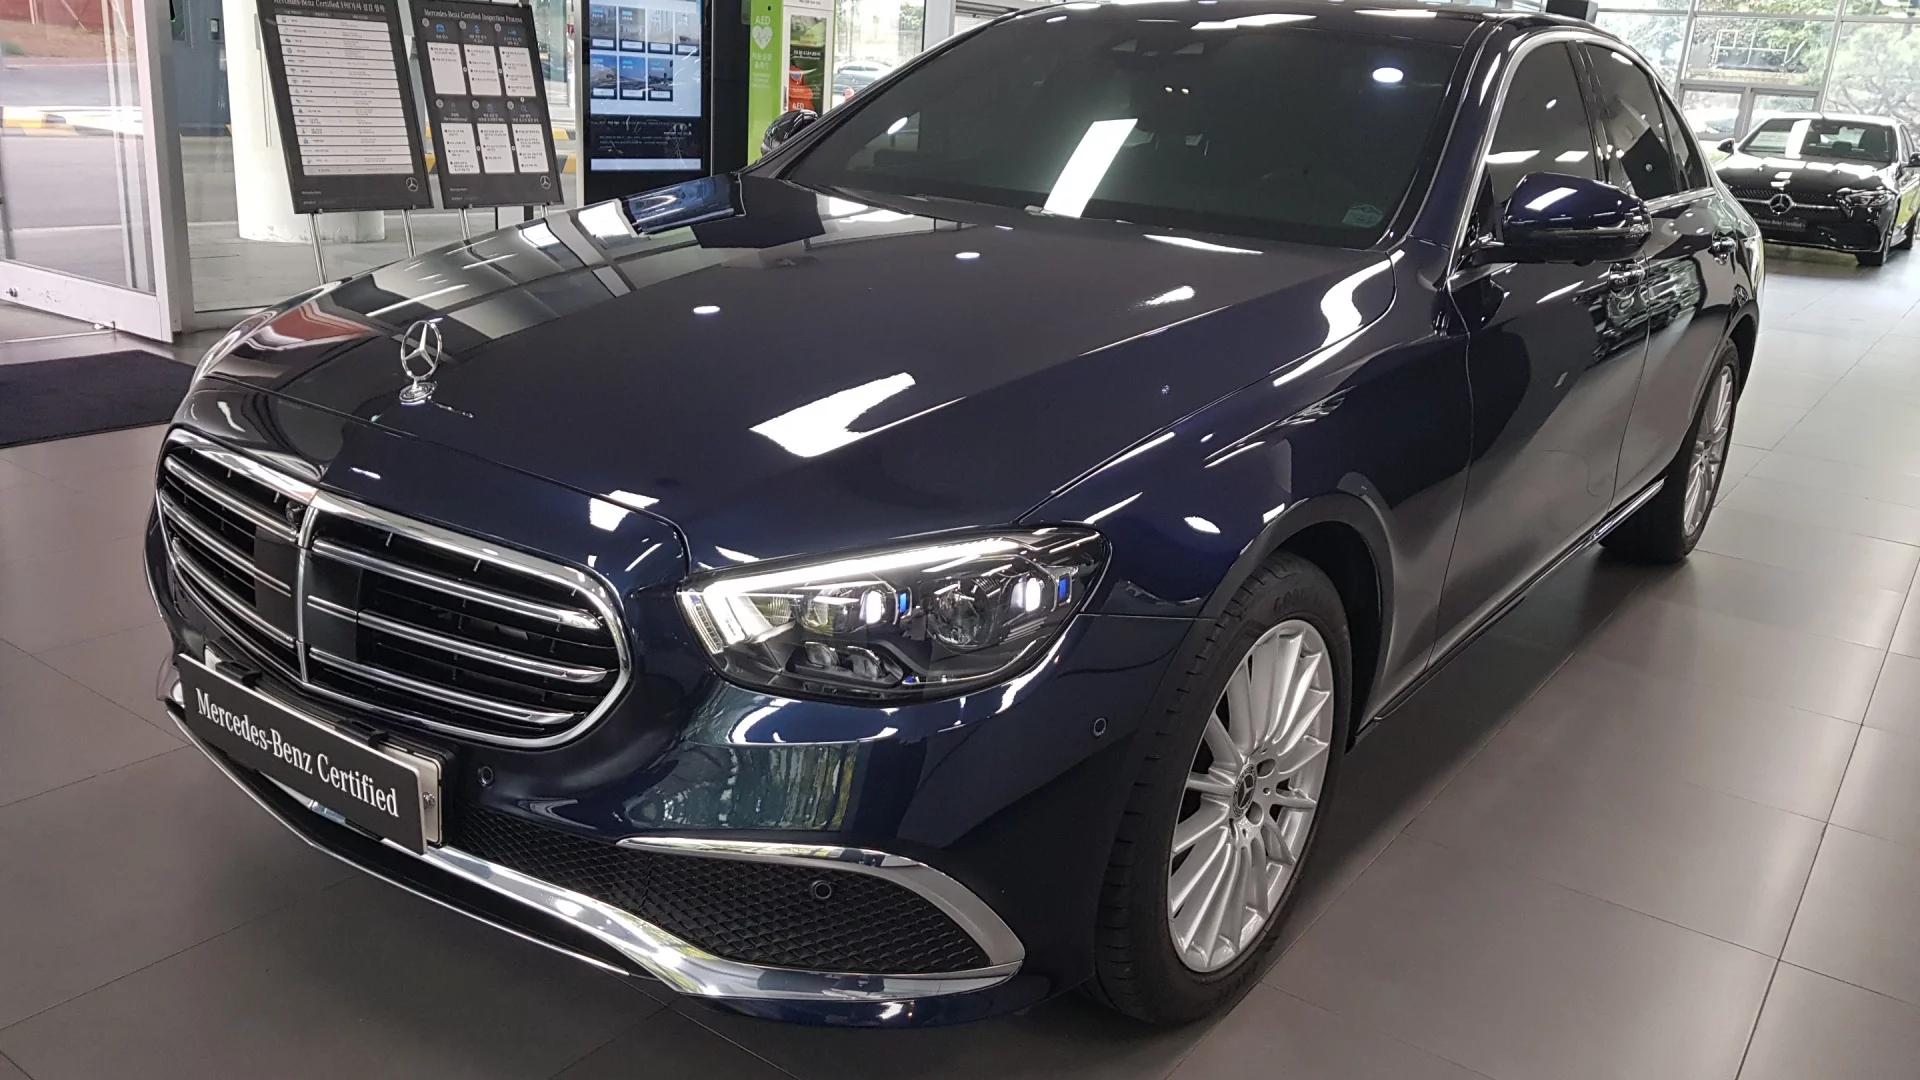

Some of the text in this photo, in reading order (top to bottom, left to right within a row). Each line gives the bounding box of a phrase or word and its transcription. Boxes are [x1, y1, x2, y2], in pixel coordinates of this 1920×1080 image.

[424, 8, 460, 18] Mercedes-Benz
[460, 12, 481, 20] Certified
[755, 16, 771, 24] AED
[195, 687, 400, 818] Mercedes-Benz Certified
